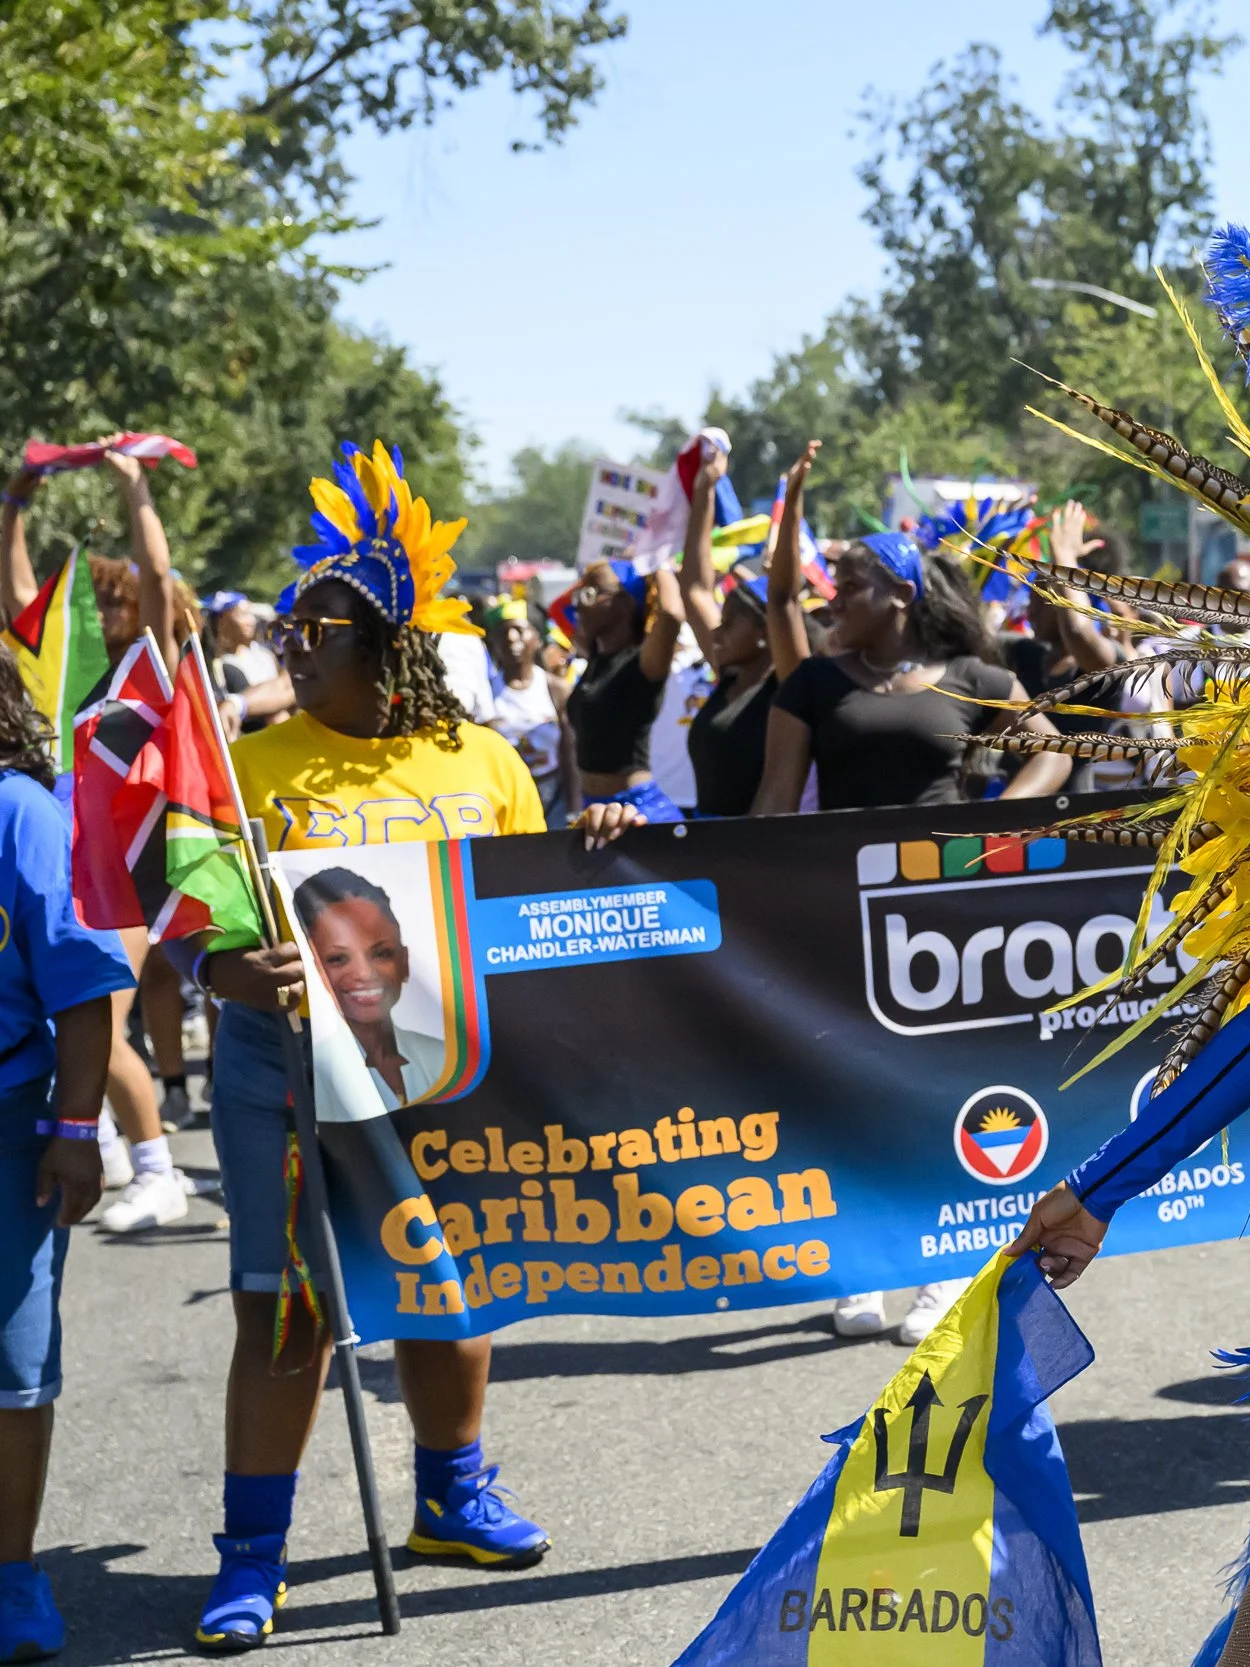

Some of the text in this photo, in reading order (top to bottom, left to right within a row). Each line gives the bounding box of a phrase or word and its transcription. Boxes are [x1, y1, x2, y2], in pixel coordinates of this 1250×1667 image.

[519, 890, 667, 917] ASSEMBLYMEMBER
[530, 906, 661, 940] MONIQUE
[487, 927, 705, 964] CHANDLER-WATERMAN
[411, 1107, 780, 1181] Celebrating
[380, 1167, 837, 1265] Caribbean
[938, 1190, 1048, 1227] ANTIGU
[1157, 1194, 1205, 1222] 60TH
[920, 1222, 1026, 1258] BARBUD
[396, 1239, 831, 1315] Independence
[779, 1587, 1015, 1641] BARBADOS
